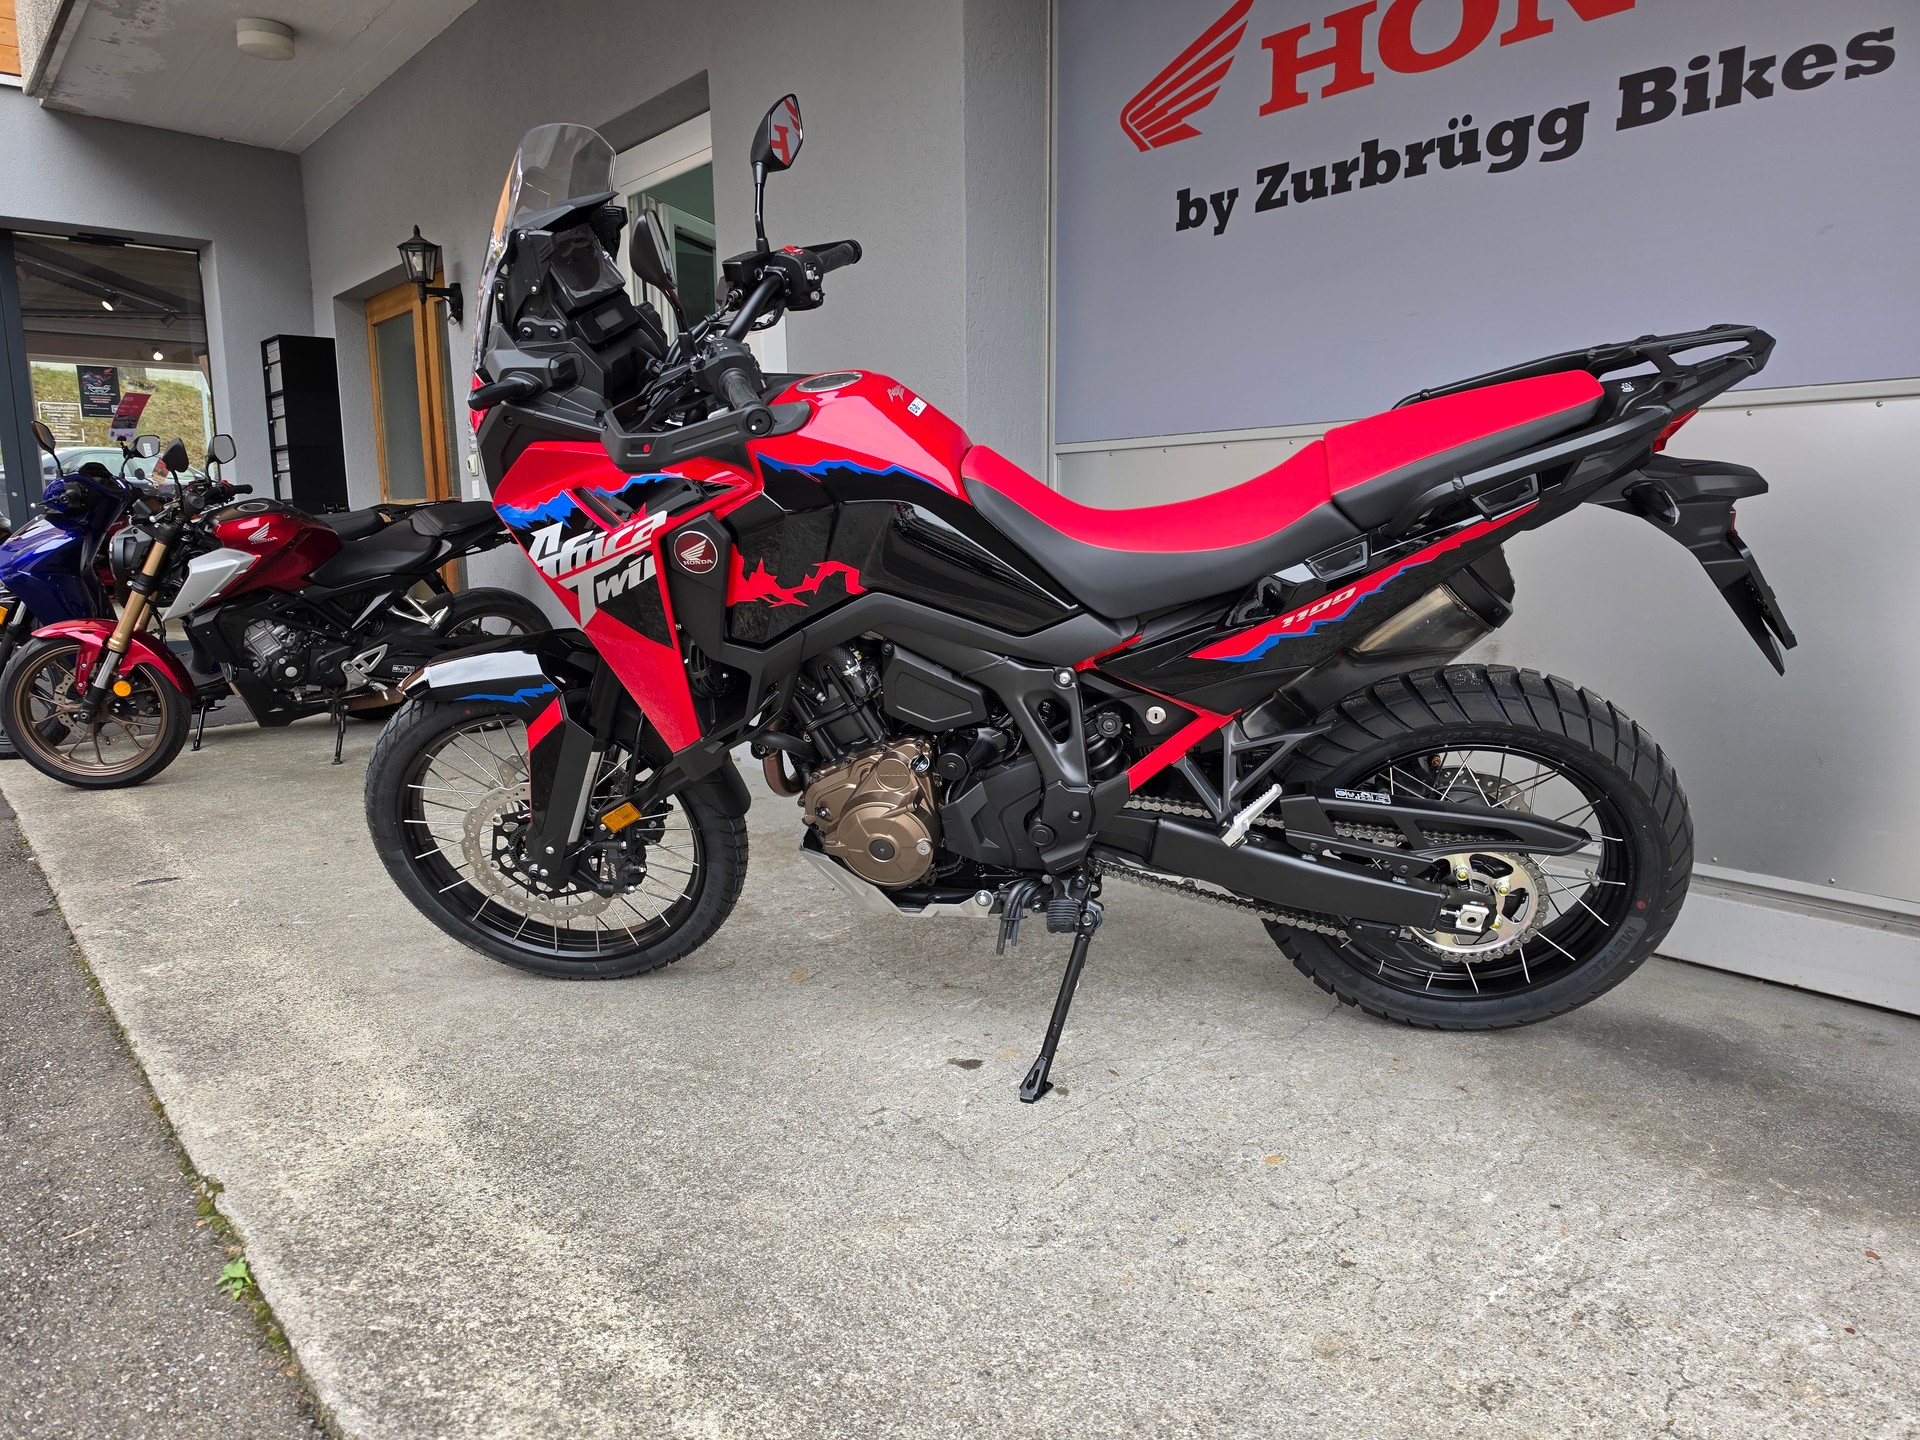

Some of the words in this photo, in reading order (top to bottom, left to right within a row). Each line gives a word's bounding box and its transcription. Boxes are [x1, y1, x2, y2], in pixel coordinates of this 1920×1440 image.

[1175, 187, 1239, 236] by
[1254, 100, 1590, 215] Zurbrügg
[1615, 25, 1897, 133] Bikes
[528, 510, 667, 579] Africa
[682, 558, 714, 566] HONDA
[1281, 587, 1357, 629] 1100
